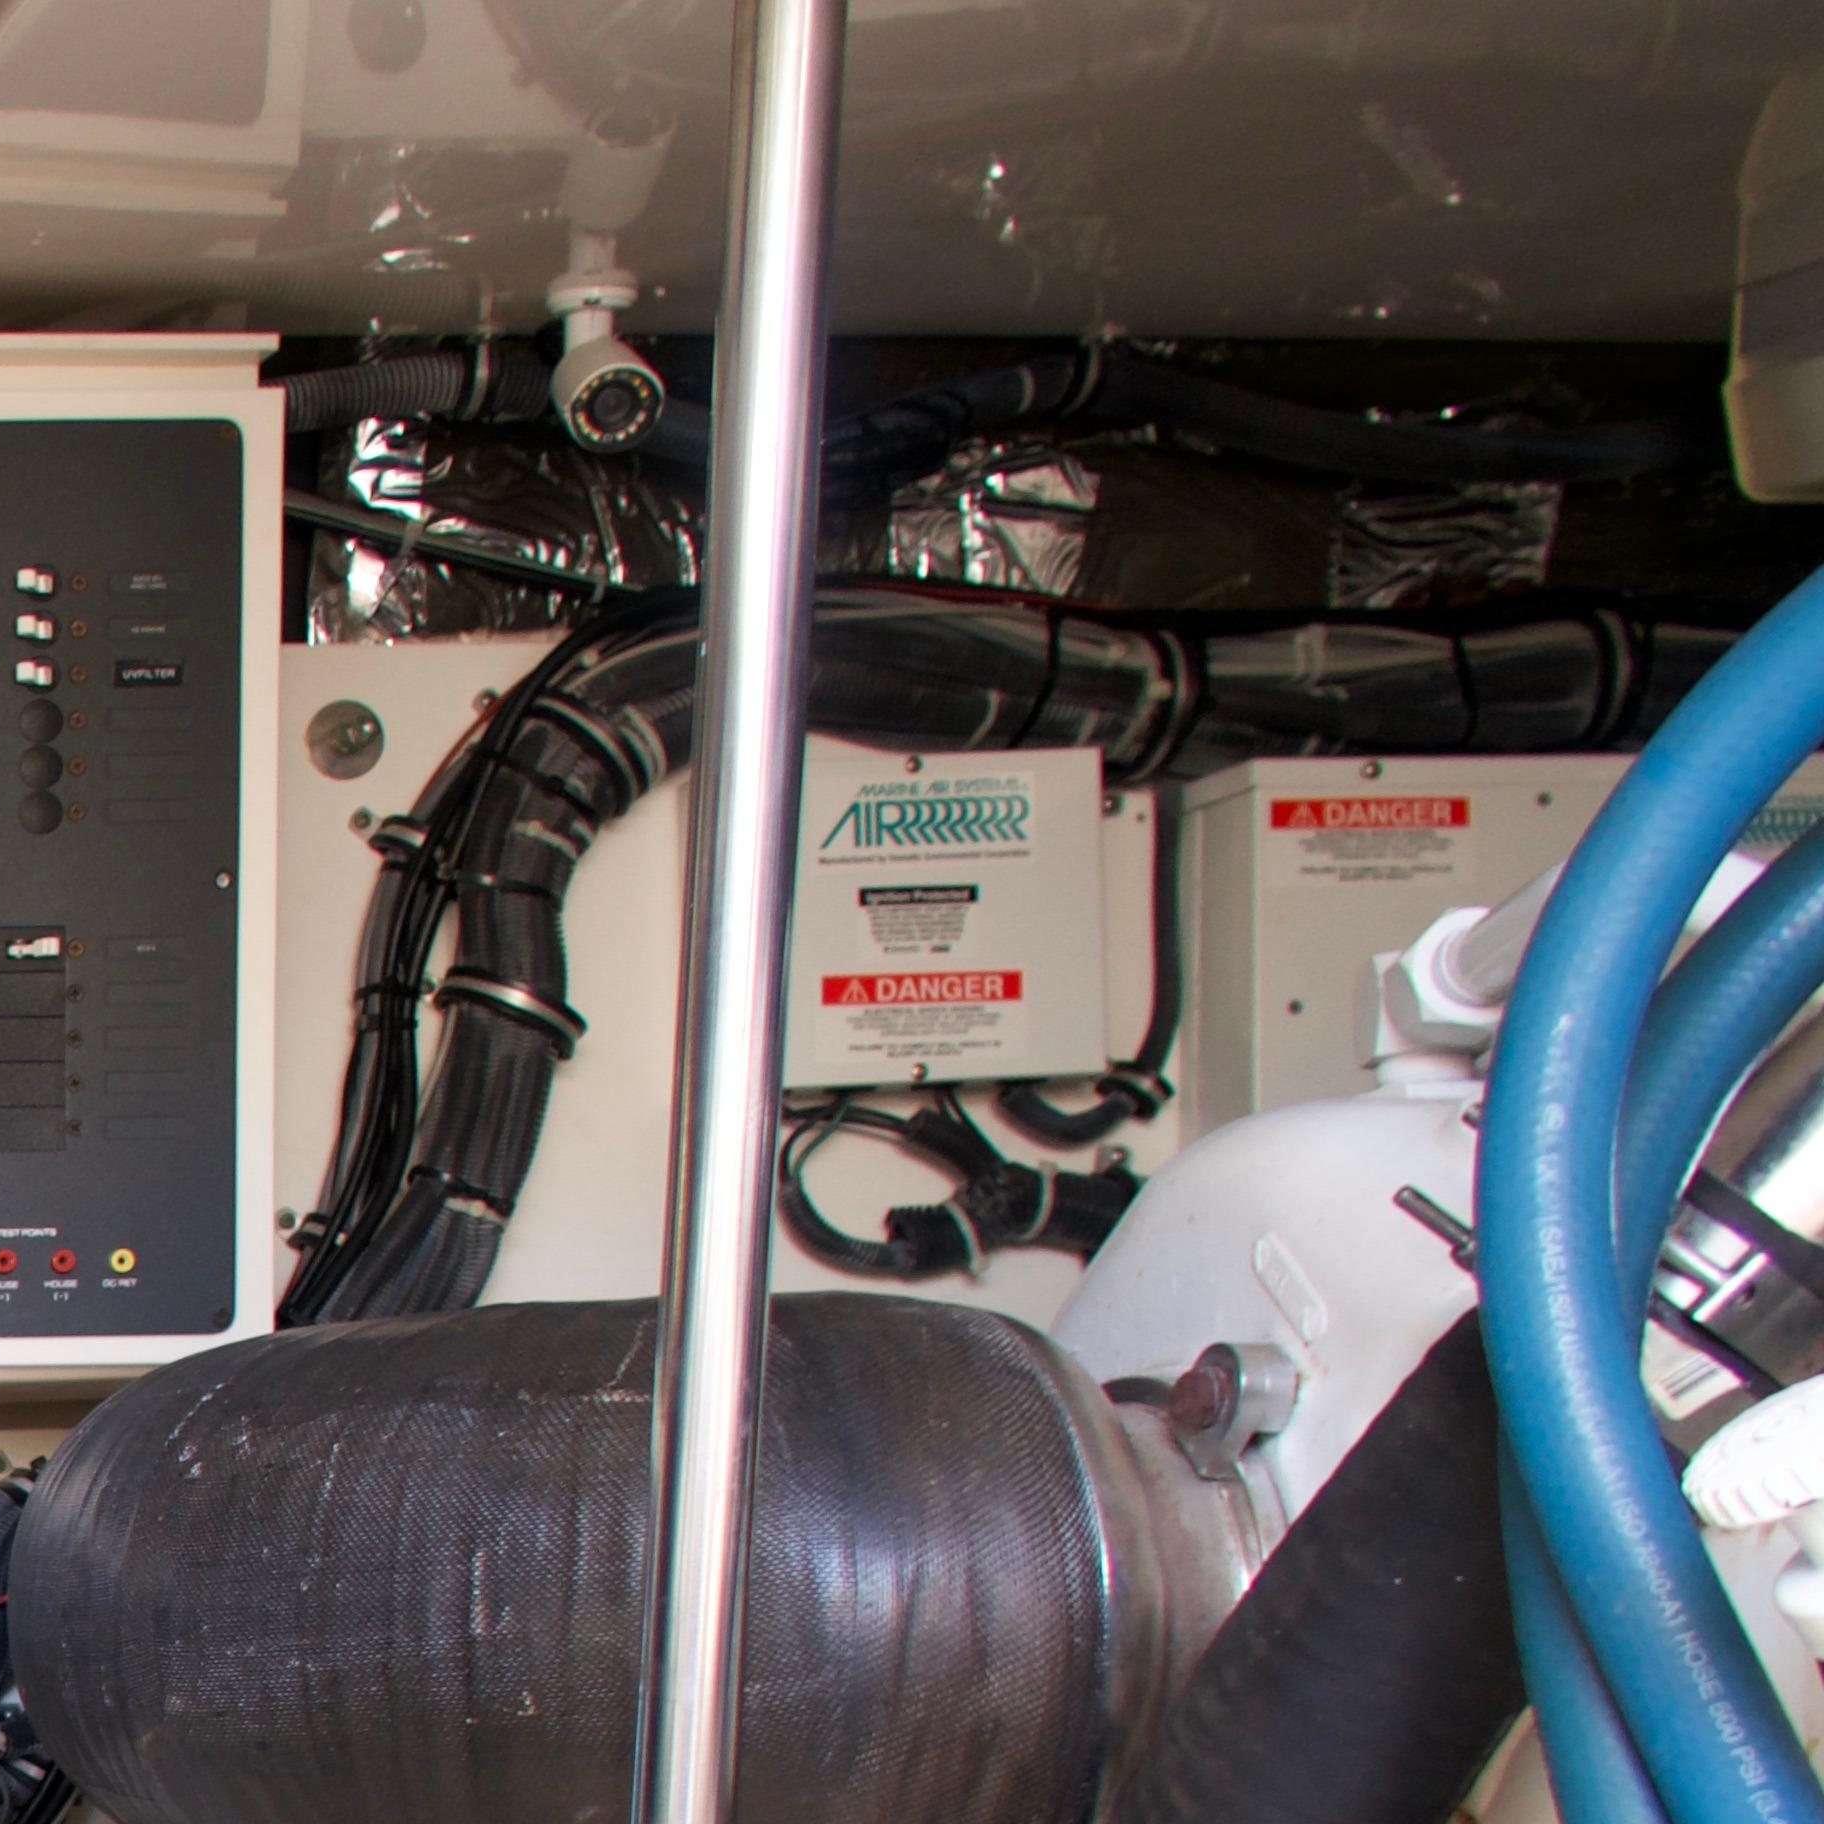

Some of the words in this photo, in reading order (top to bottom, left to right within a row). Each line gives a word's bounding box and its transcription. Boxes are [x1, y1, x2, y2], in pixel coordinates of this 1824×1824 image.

[1325, 801, 1452, 826] DANGER
[876, 974, 1004, 1002] DANGER
[21, 1228, 57, 1238] POINTS
[44, 1279, 78, 1289] HOUSE
[1675, 1631, 1726, 1701] HOSE
[1731, 1745, 1768, 1787] PSI
